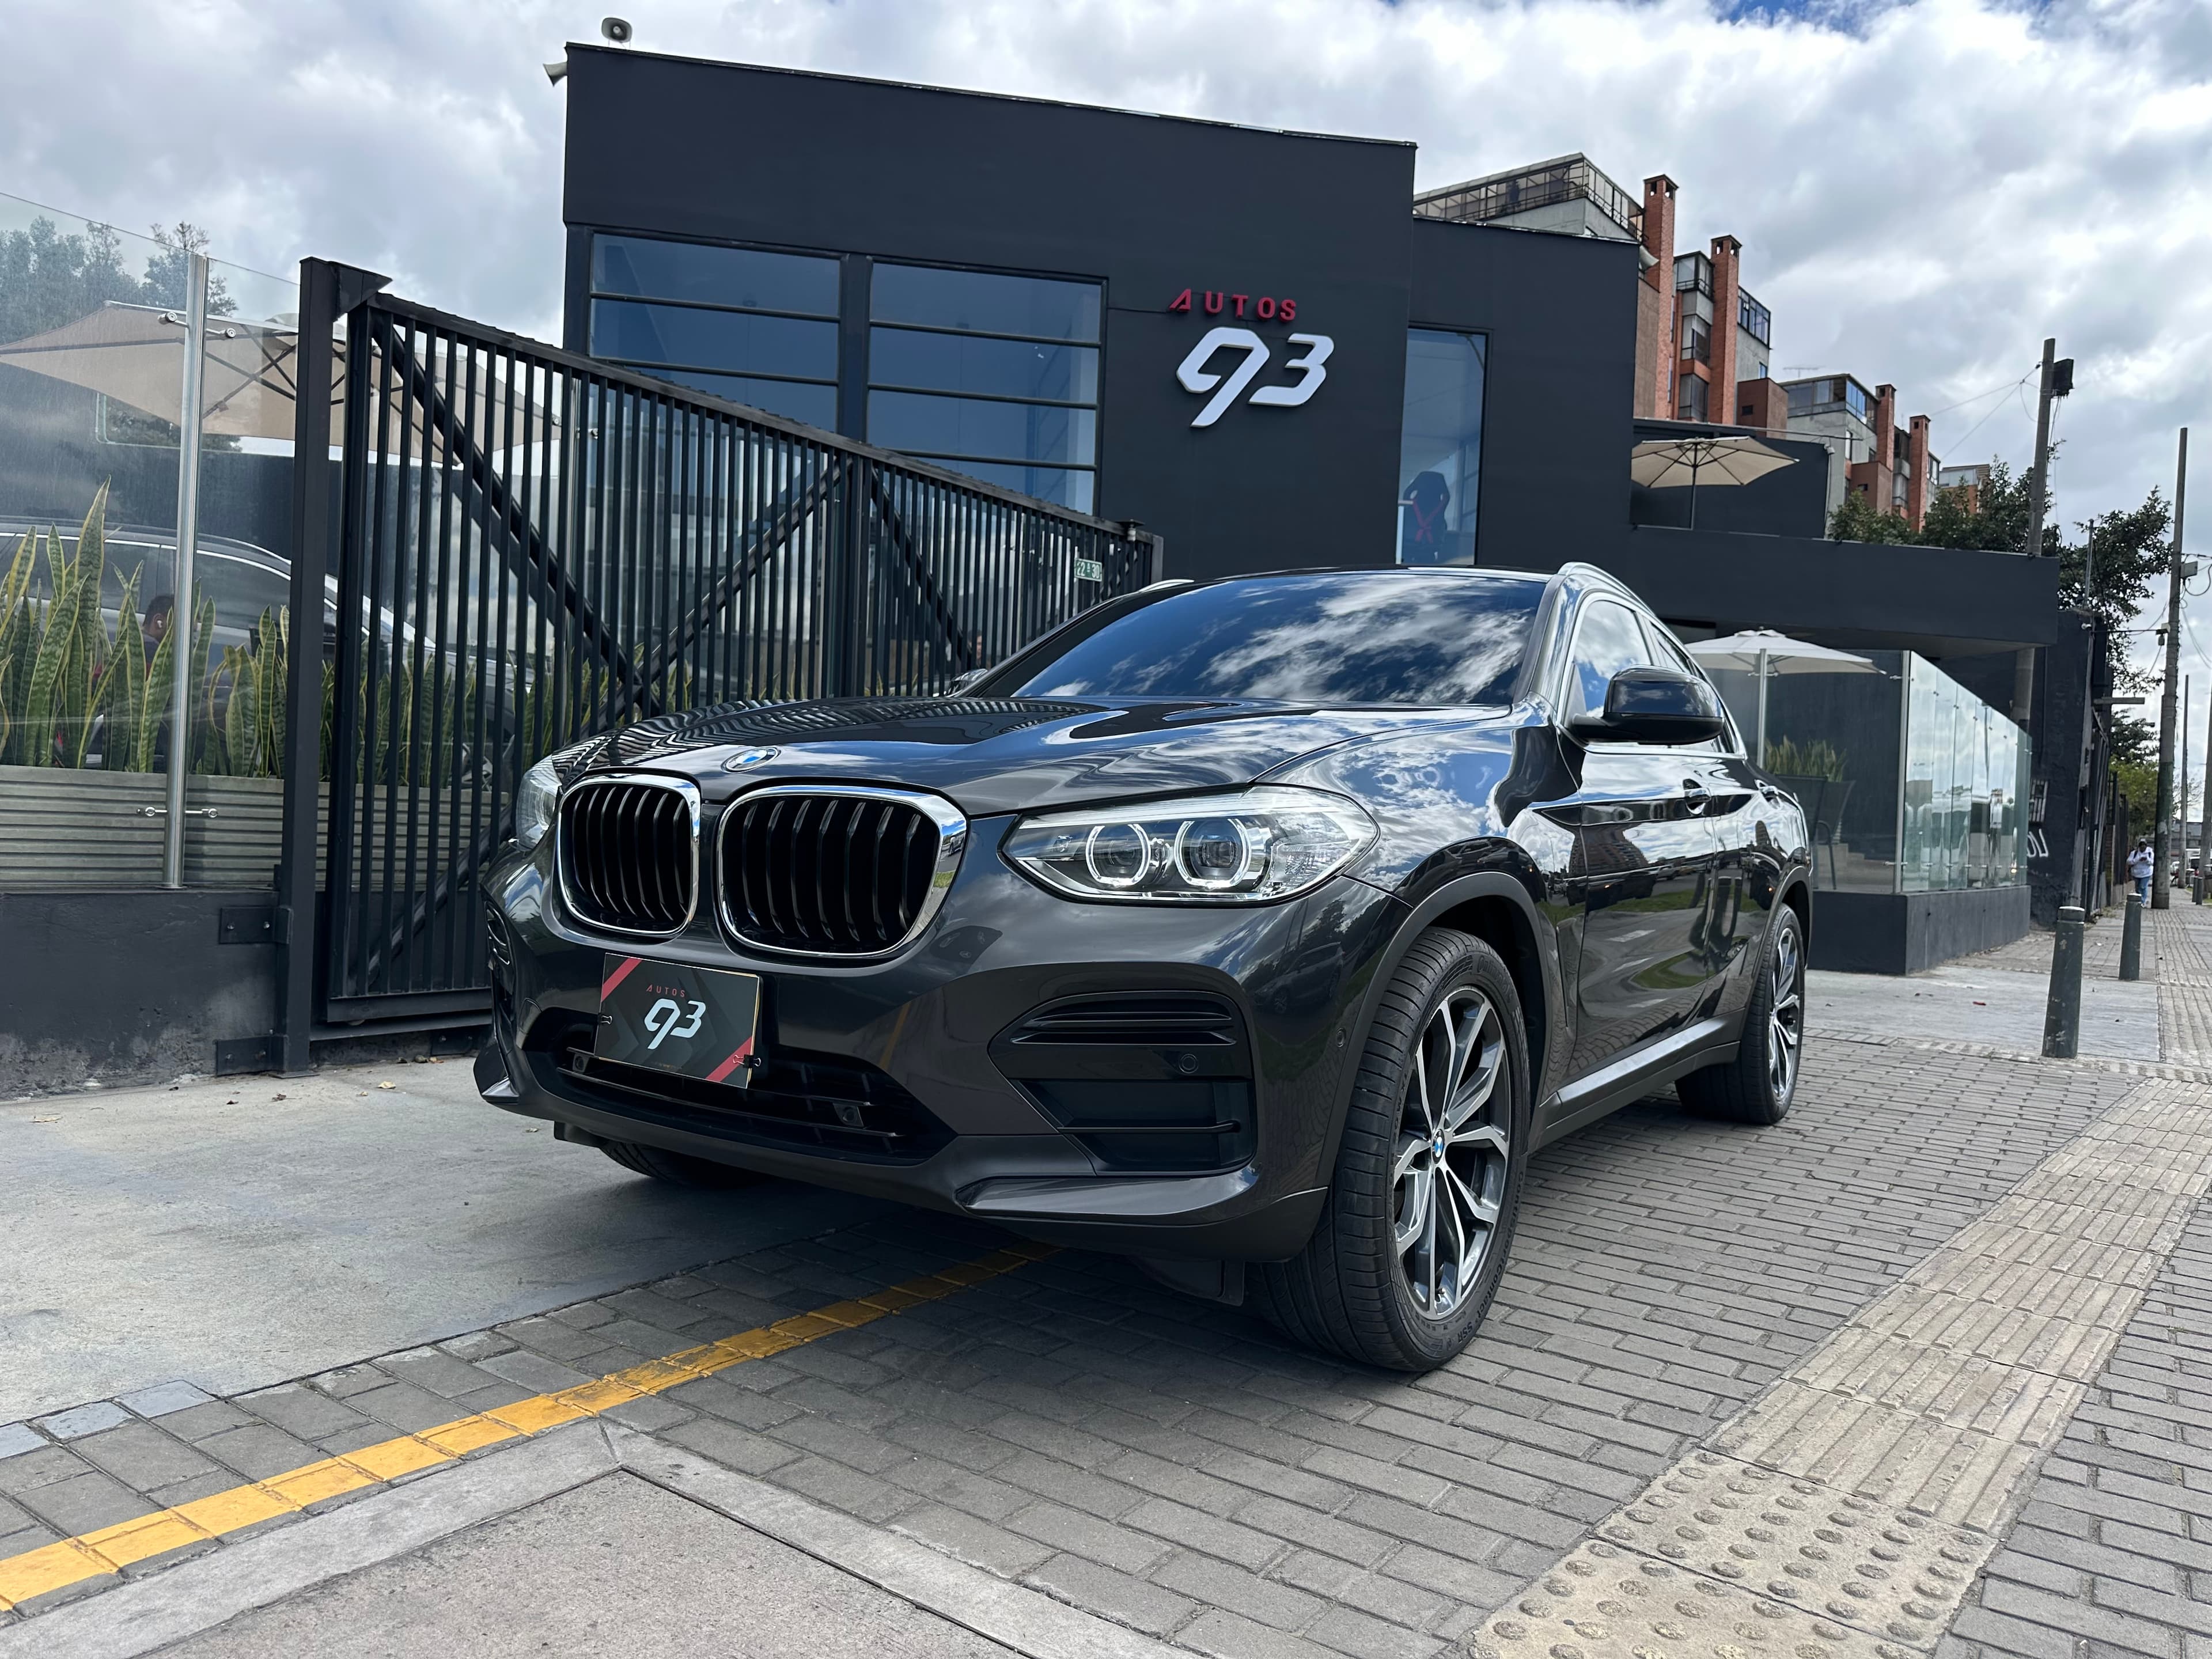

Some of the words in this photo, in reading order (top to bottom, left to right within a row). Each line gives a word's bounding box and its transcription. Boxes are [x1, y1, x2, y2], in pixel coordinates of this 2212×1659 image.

[1169, 289, 1296, 322] AUTOS
[1176, 326, 1335, 428] 93
[1077, 562, 1085, 577] 22
[1092, 563, 1100, 579] 30
[646, 984, 685, 998] AUTOS
[644, 998, 706, 1050] 93
[1457, 1323, 1474, 1344] SSR
